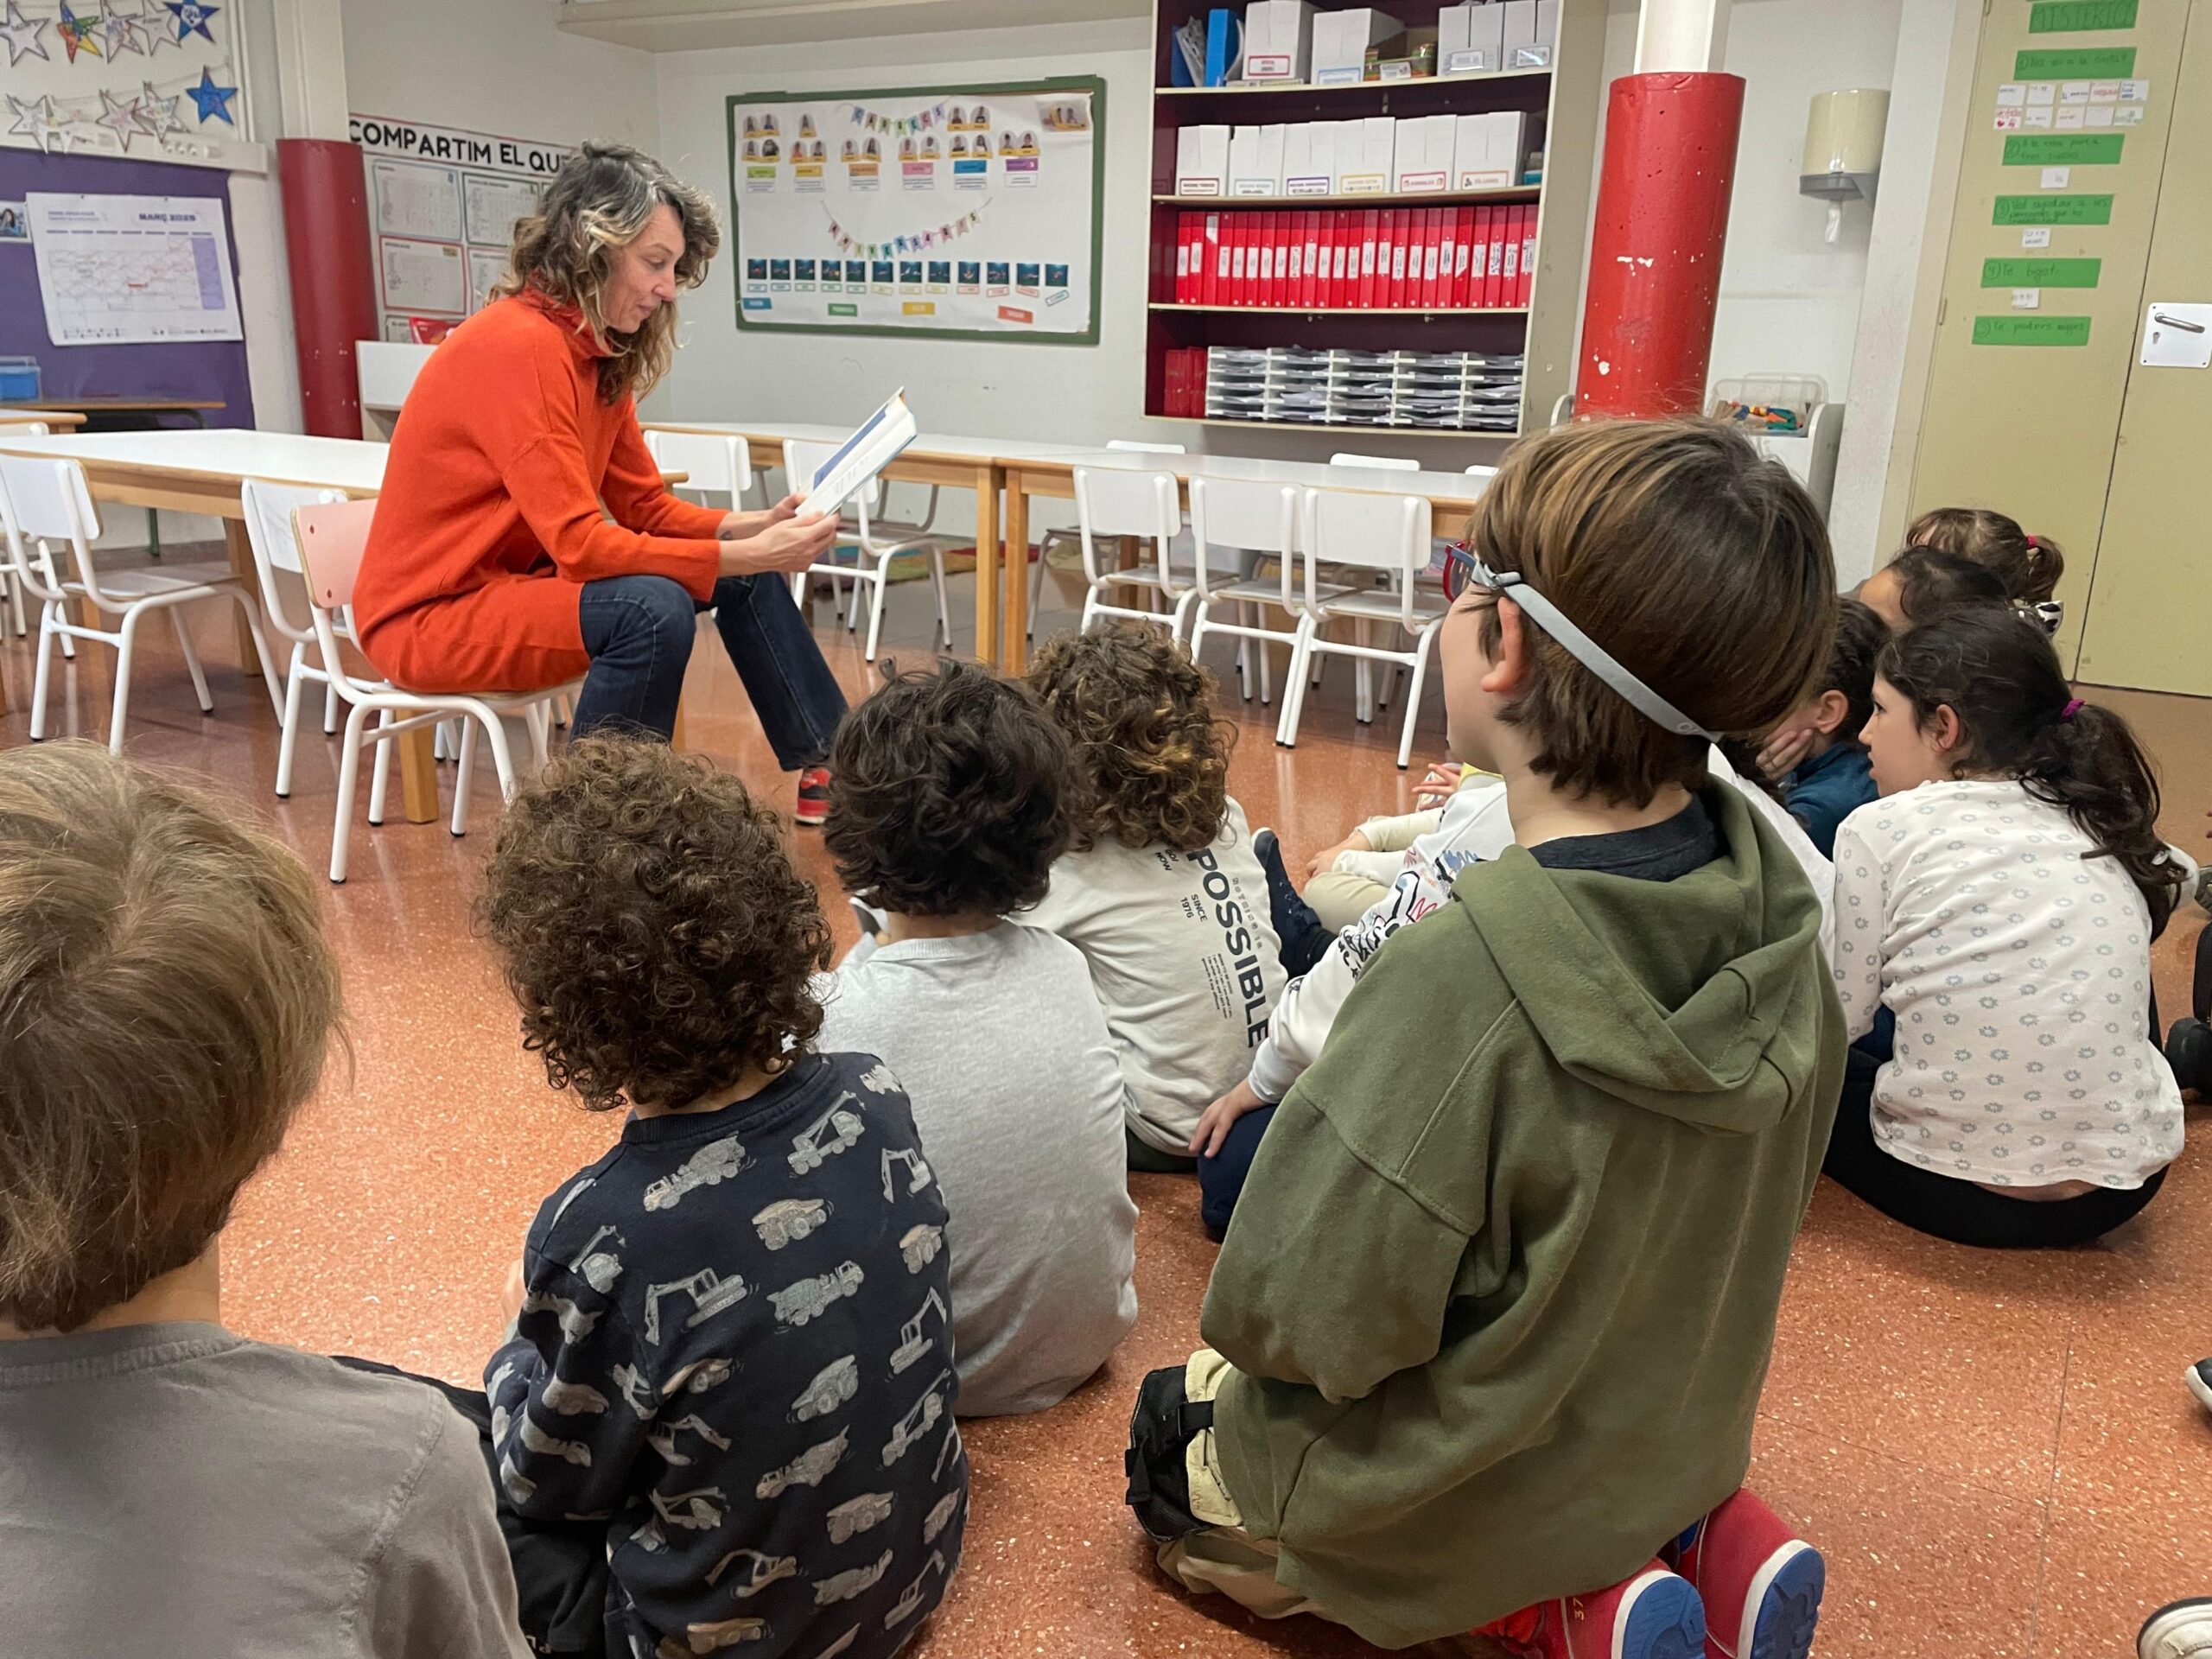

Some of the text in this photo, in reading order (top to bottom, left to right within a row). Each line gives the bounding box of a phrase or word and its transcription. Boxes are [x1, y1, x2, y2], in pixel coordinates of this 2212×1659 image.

[348, 120, 570, 173] COMPARTIM EL QU
[1155, 851, 1172, 871] NOW
[1180, 897, 1194, 918] 1976
[1192, 893, 1208, 923] SINCE
